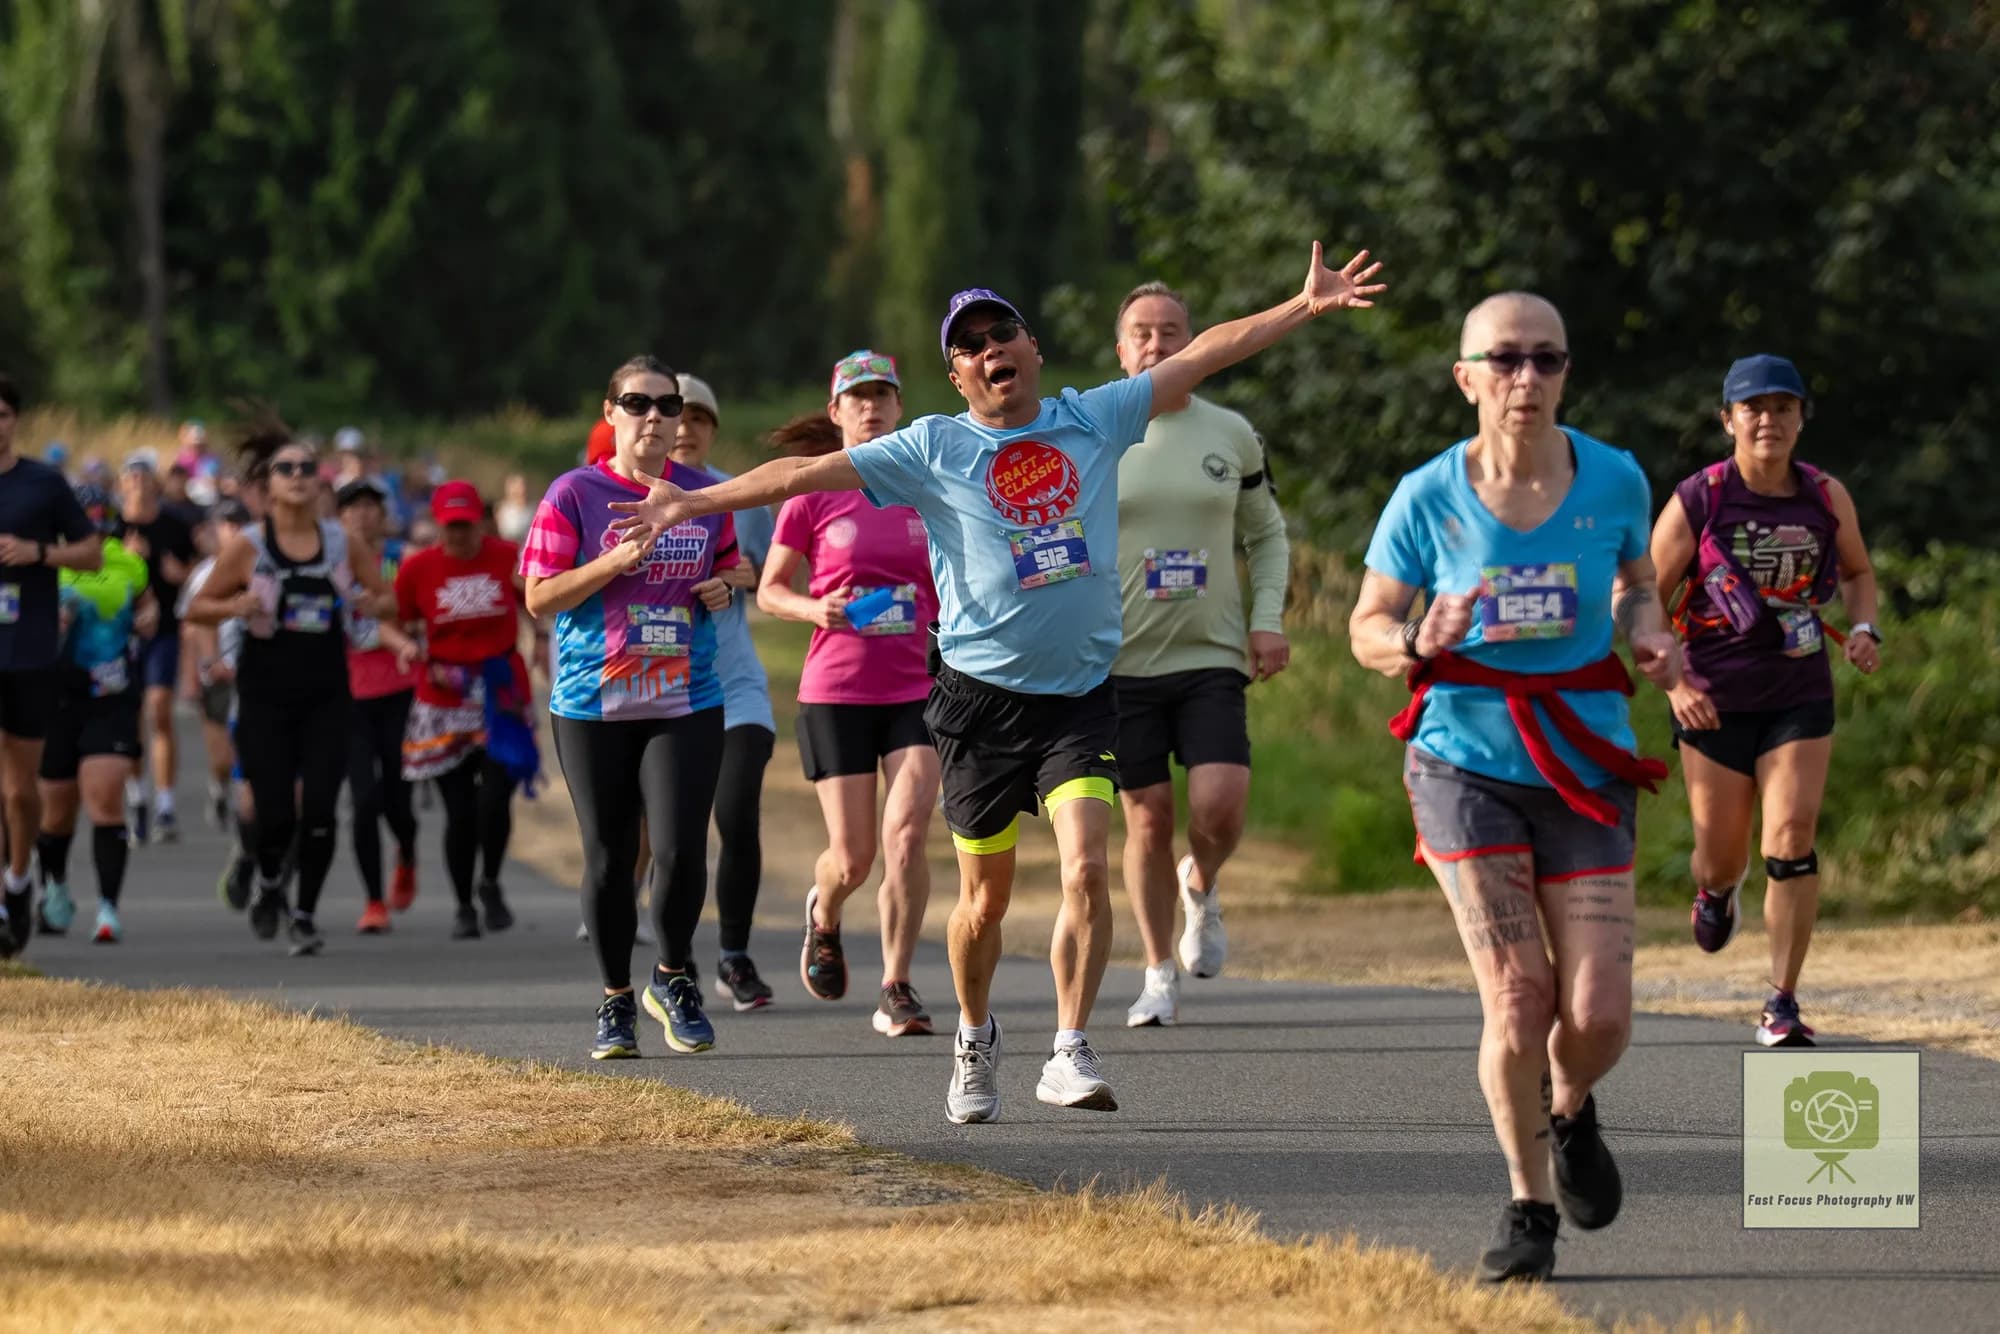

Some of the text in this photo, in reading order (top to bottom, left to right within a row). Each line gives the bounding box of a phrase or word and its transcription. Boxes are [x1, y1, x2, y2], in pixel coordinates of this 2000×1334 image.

[995, 455, 1037, 488] CRAFT
[1004, 457, 1060, 498] CLASSIC
[643, 549, 698, 562] ossom
[1033, 545, 1070, 571] 512
[645, 562, 705, 584] Run
[1498, 592, 1562, 621] 1254
[641, 625, 677, 643] 856
